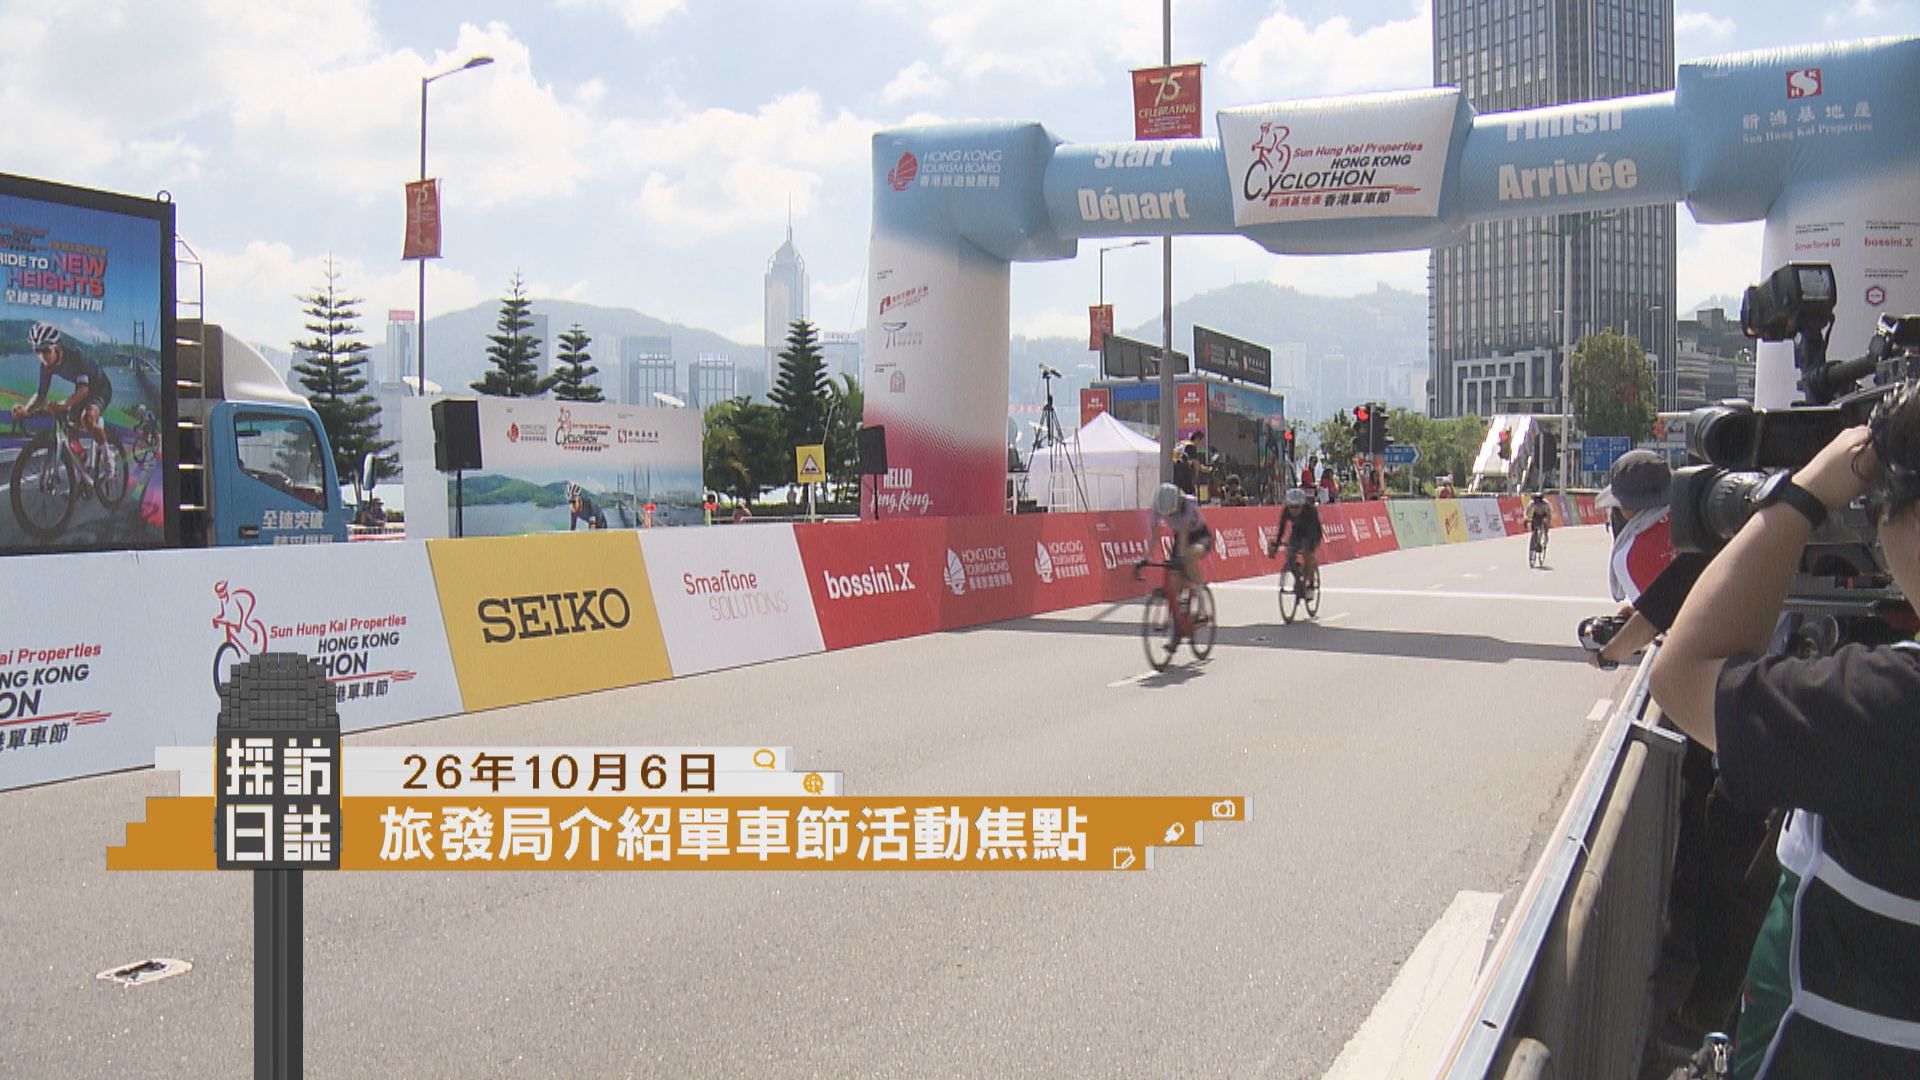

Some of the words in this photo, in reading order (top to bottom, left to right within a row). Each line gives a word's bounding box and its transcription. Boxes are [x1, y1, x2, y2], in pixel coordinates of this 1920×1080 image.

[1150, 71, 1183, 107] 75
[923, 150, 961, 162] HONG
[963, 150, 1002, 162] KONG
[1294, 148, 1313, 158] Sun
[1315, 145, 1343, 157] Hung
[1345, 144, 1363, 154] Kai
[1365, 141, 1423, 153] Properties
[1331, 156, 1370, 170] HONG
[1371, 154, 1412, 168] KONG
[1498, 152, 1638, 201] Arrivée
[1077, 186, 1190, 224] Départ
[29, 256, 48, 270] TO
[50, 250, 107, 278] NEW
[8, 267, 106, 298] HEIGHTS
[884, 468, 912, 489] HELLO
[683, 569, 758, 596] SmarTone
[823, 562, 915, 600] bossini.X
[478, 587, 631, 644] SEIKO
[708, 589, 789, 621] SOLUTIONS
[270, 626, 293, 640] Sun
[296, 622, 327, 637] Hung
[329, 618, 348, 633] Kai
[350, 614, 408, 632] Properties
[0, 650, 14, 666] ai
[17, 643, 103, 664] Properties
[318, 635, 358, 653] HONG
[361, 632, 400, 649] KONG
[0, 670, 29, 690] NG
[32, 663, 90, 687] KONG
[0, 688, 42, 720] ON
